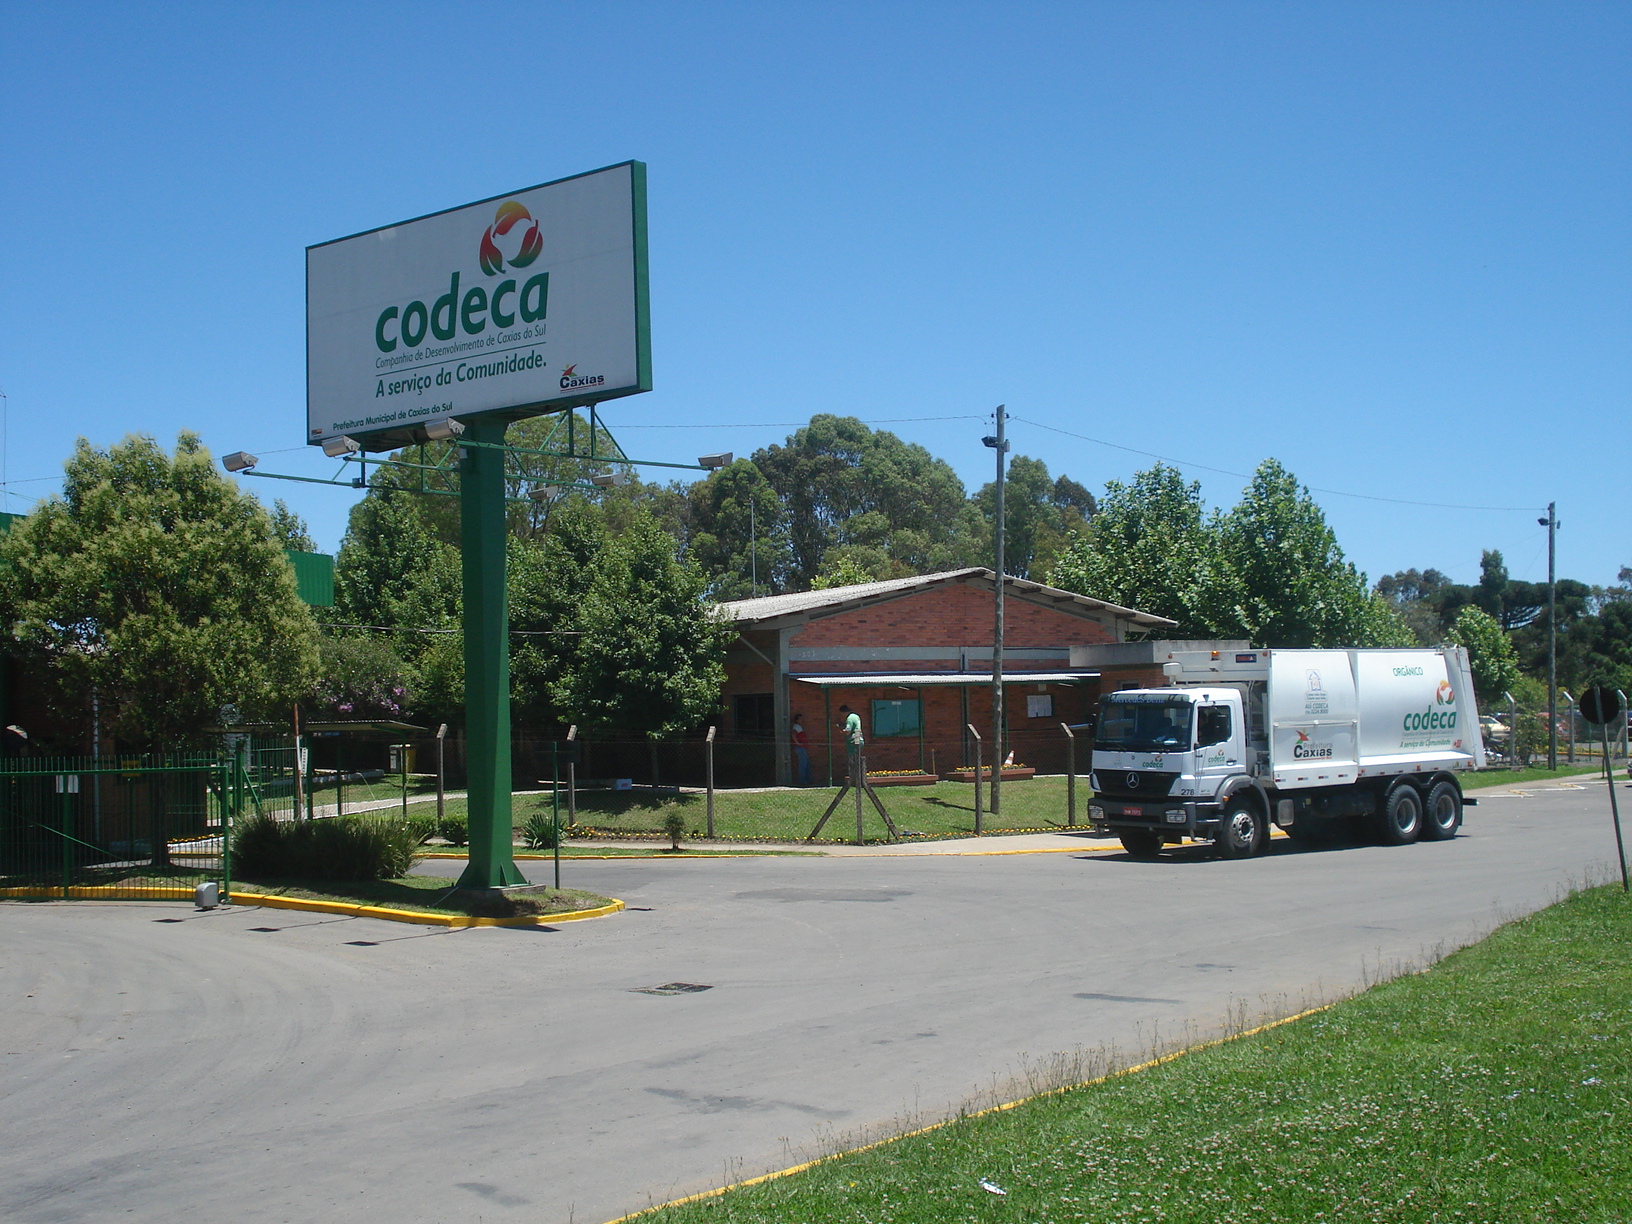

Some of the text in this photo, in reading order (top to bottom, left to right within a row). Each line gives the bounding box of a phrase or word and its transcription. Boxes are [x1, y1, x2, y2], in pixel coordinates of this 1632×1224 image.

[375, 271, 549, 353] codeca
[376, 324, 546, 369] Companhia de Desenvolvimento de Caxias do Sul
[375, 350, 547, 398] A serviço da Comunidade.
[560, 375, 604, 388] Caxias
[333, 402, 453, 431] Prefeitura Municipal de Caxias do Sul
[1393, 665, 1423, 676] ORGÂNICO
[1403, 705, 1457, 731] codeca
[1207, 755, 1225, 763] codeca
[1294, 744, 1332, 758] Caxias
[1142, 760, 1163, 768] codeca
